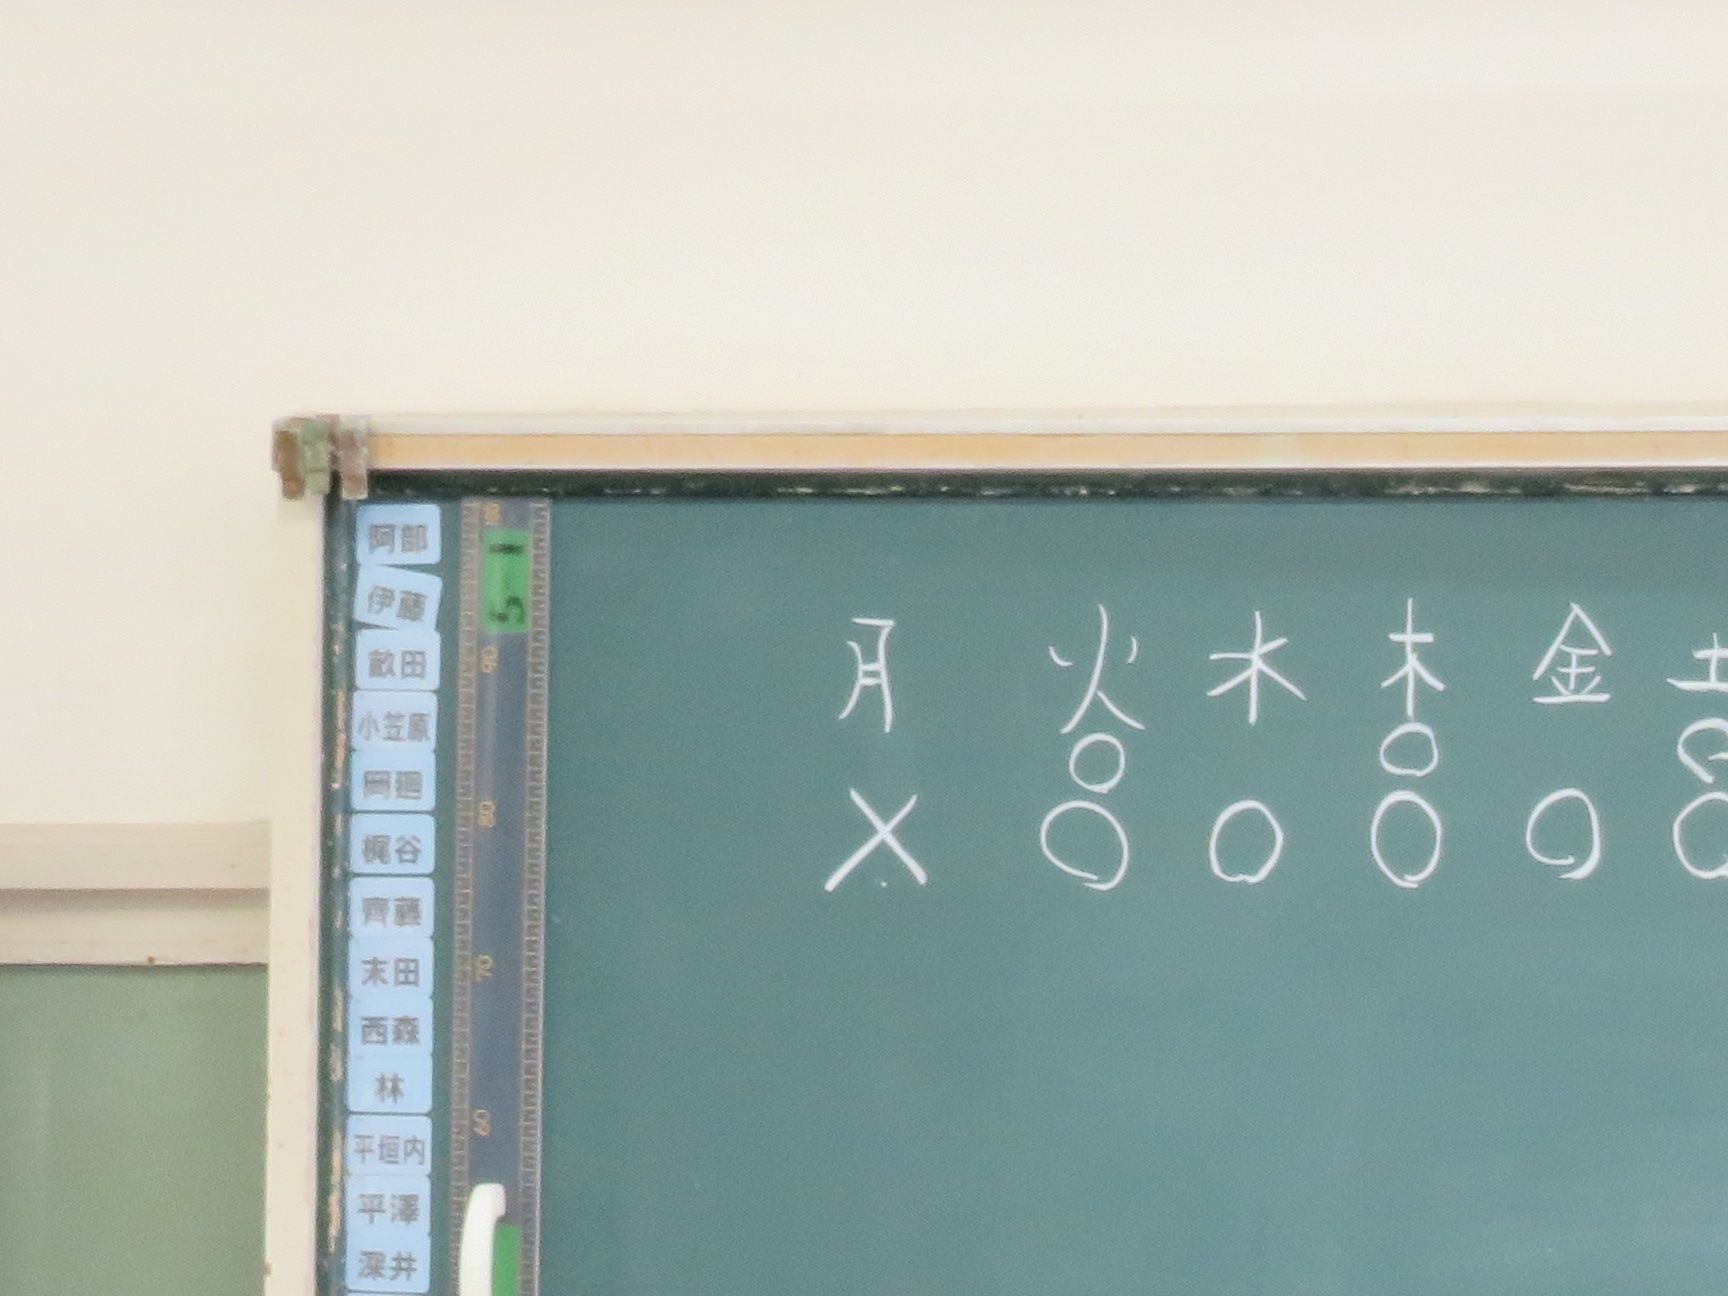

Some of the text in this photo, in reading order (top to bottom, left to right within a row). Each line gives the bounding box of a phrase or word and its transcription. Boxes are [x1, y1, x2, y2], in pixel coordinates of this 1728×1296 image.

[368, 523, 428, 554] 阿部
[838, 617, 896, 734] 月
[1048, 604, 1147, 735] 火
[1206, 610, 1308, 726] 水
[1381, 597, 1446, 721] 木
[1532, 602, 1612, 704] 金
[358, 711, 430, 741] 小笠原
[361, 957, 420, 987] 末田
[361, 1016, 420, 1046] 西森
[375, 1071, 405, 1102] 林
[354, 1134, 425, 1165] 平垣内
[357, 1251, 418, 1281] 深井
